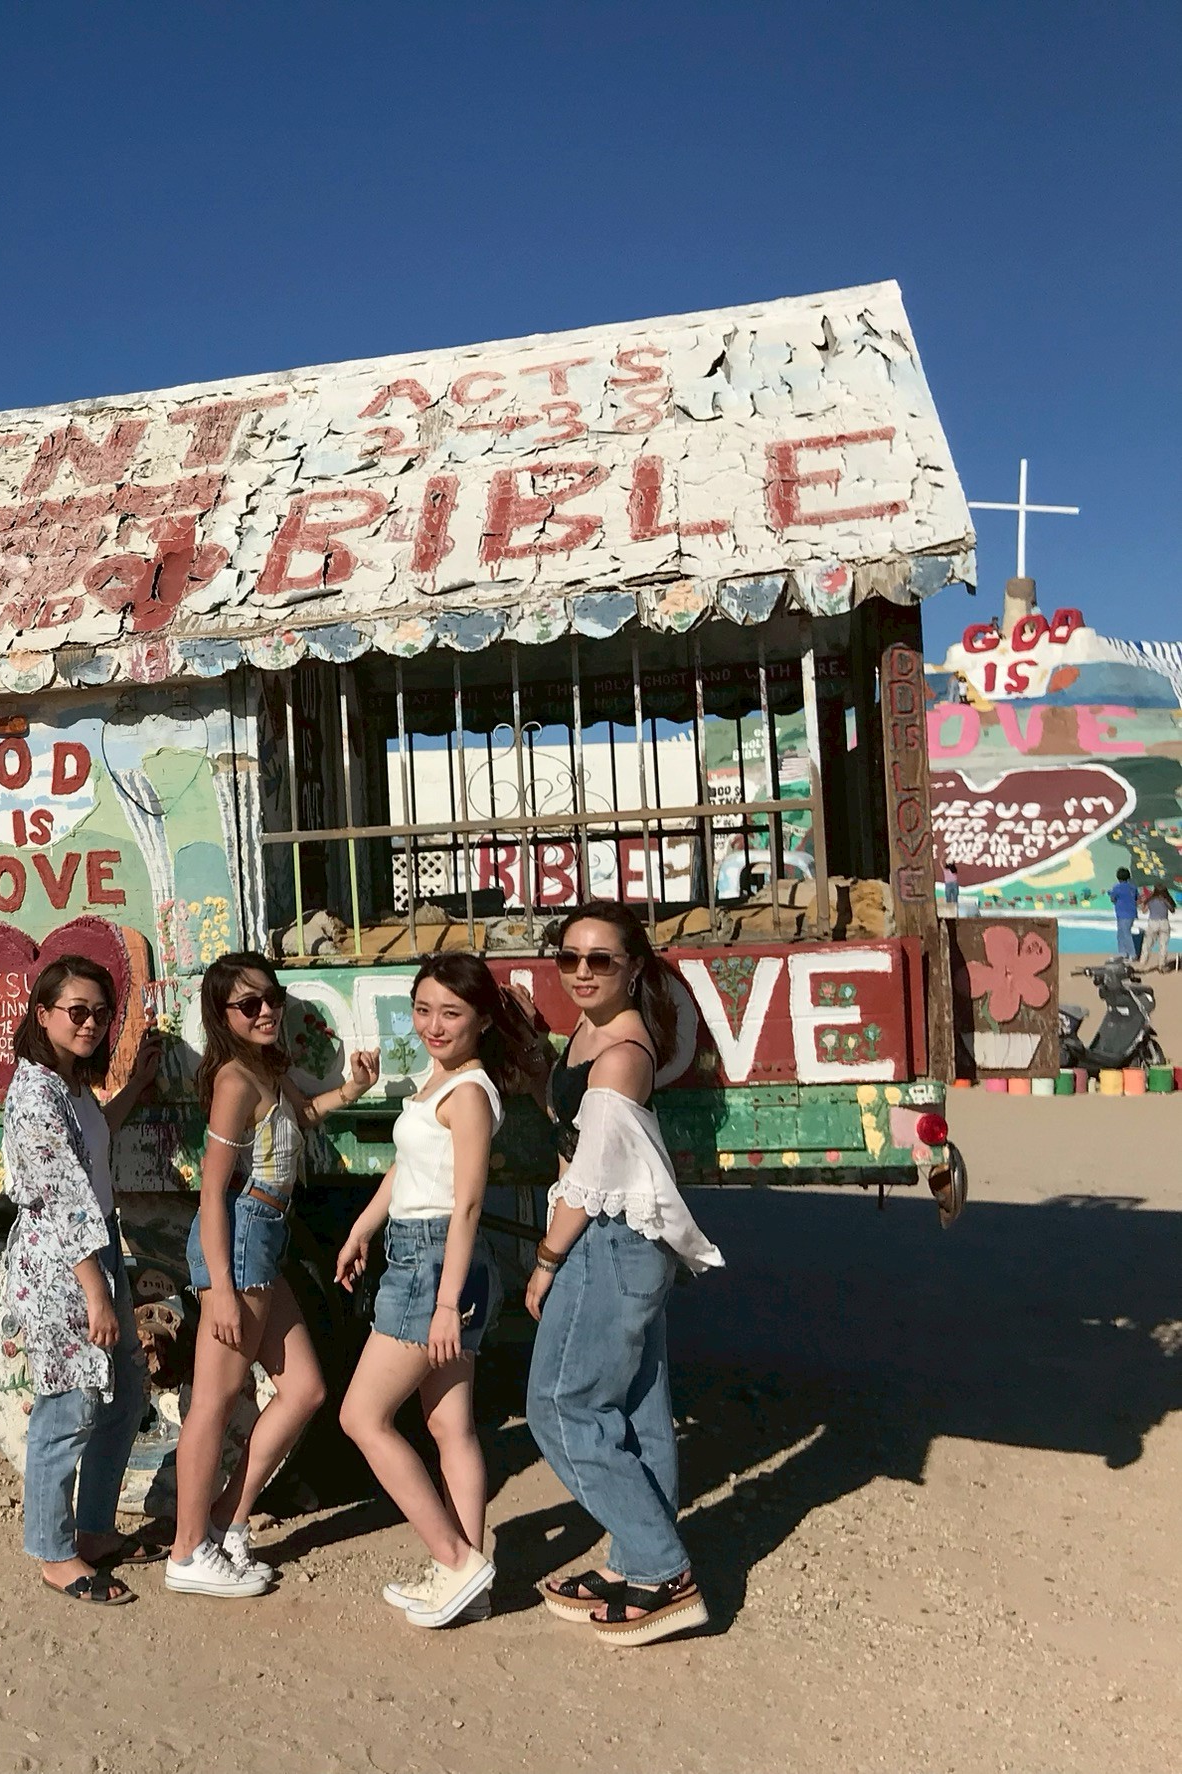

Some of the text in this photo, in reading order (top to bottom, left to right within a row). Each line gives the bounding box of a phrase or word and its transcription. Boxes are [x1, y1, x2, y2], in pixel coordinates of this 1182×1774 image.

[358, 344, 668, 419] ACTS
[256, 426, 910, 598] BIBLE
[963, 608, 1085, 654] GOD
[593, 678, 631, 693] HOLY
[642, 672, 689, 689] GHOST
[744, 663, 791, 680] WTH
[984, 660, 1038, 694] IS
[892, 722, 919, 750] IS
[927, 703, 1146, 759] OVE
[931, 796, 1114, 819] JESUS I'M
[12, 809, 54, 846] IS
[892, 760, 929, 900] LOVE
[944, 831, 1069, 851] UPON MY
[996, 817, 1099, 835] PLEASE
[989, 843, 1039, 859] INTO
[479, 835, 660, 904] BBE
